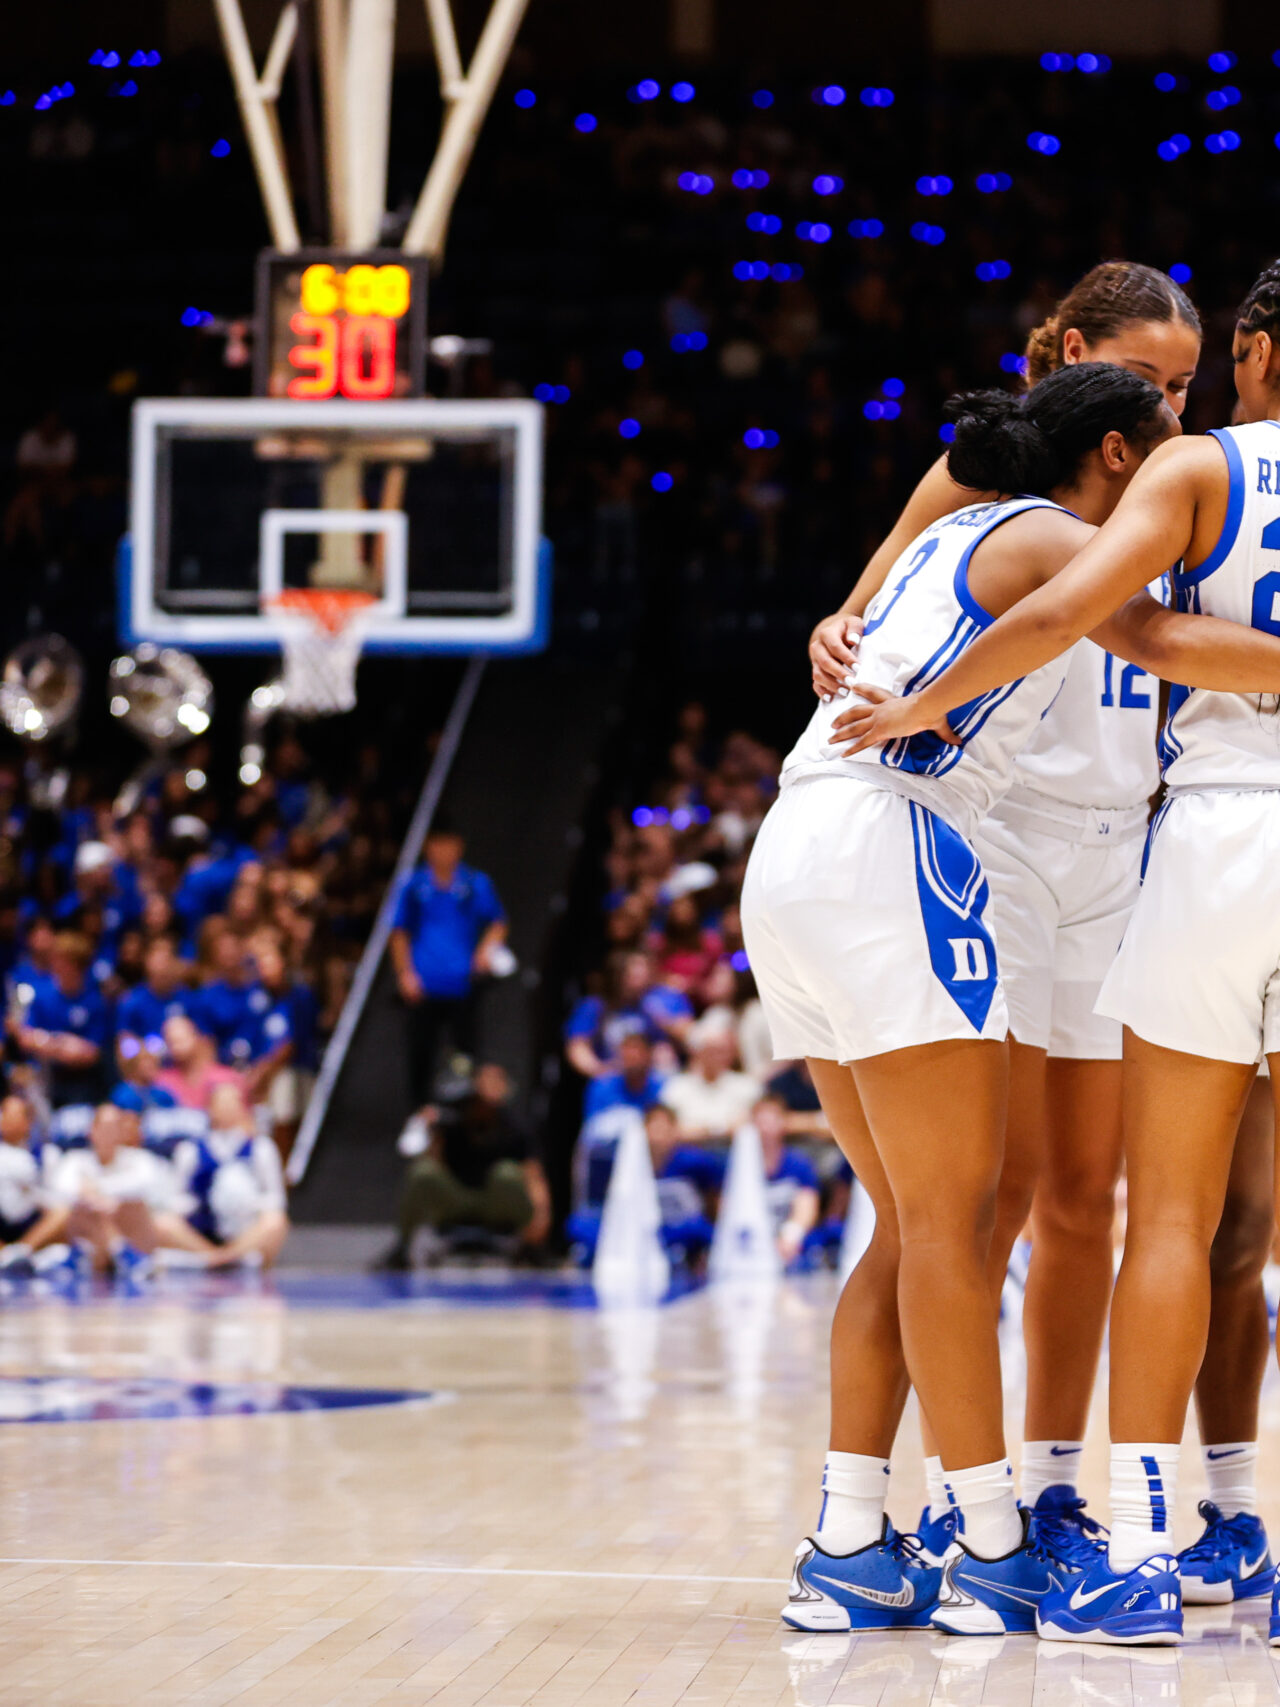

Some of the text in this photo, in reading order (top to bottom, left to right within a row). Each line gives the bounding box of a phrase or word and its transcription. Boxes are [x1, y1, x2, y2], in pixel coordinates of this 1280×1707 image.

[288, 312, 397, 400] 30
[863, 537, 940, 636] 3
[947, 938, 989, 981] D
